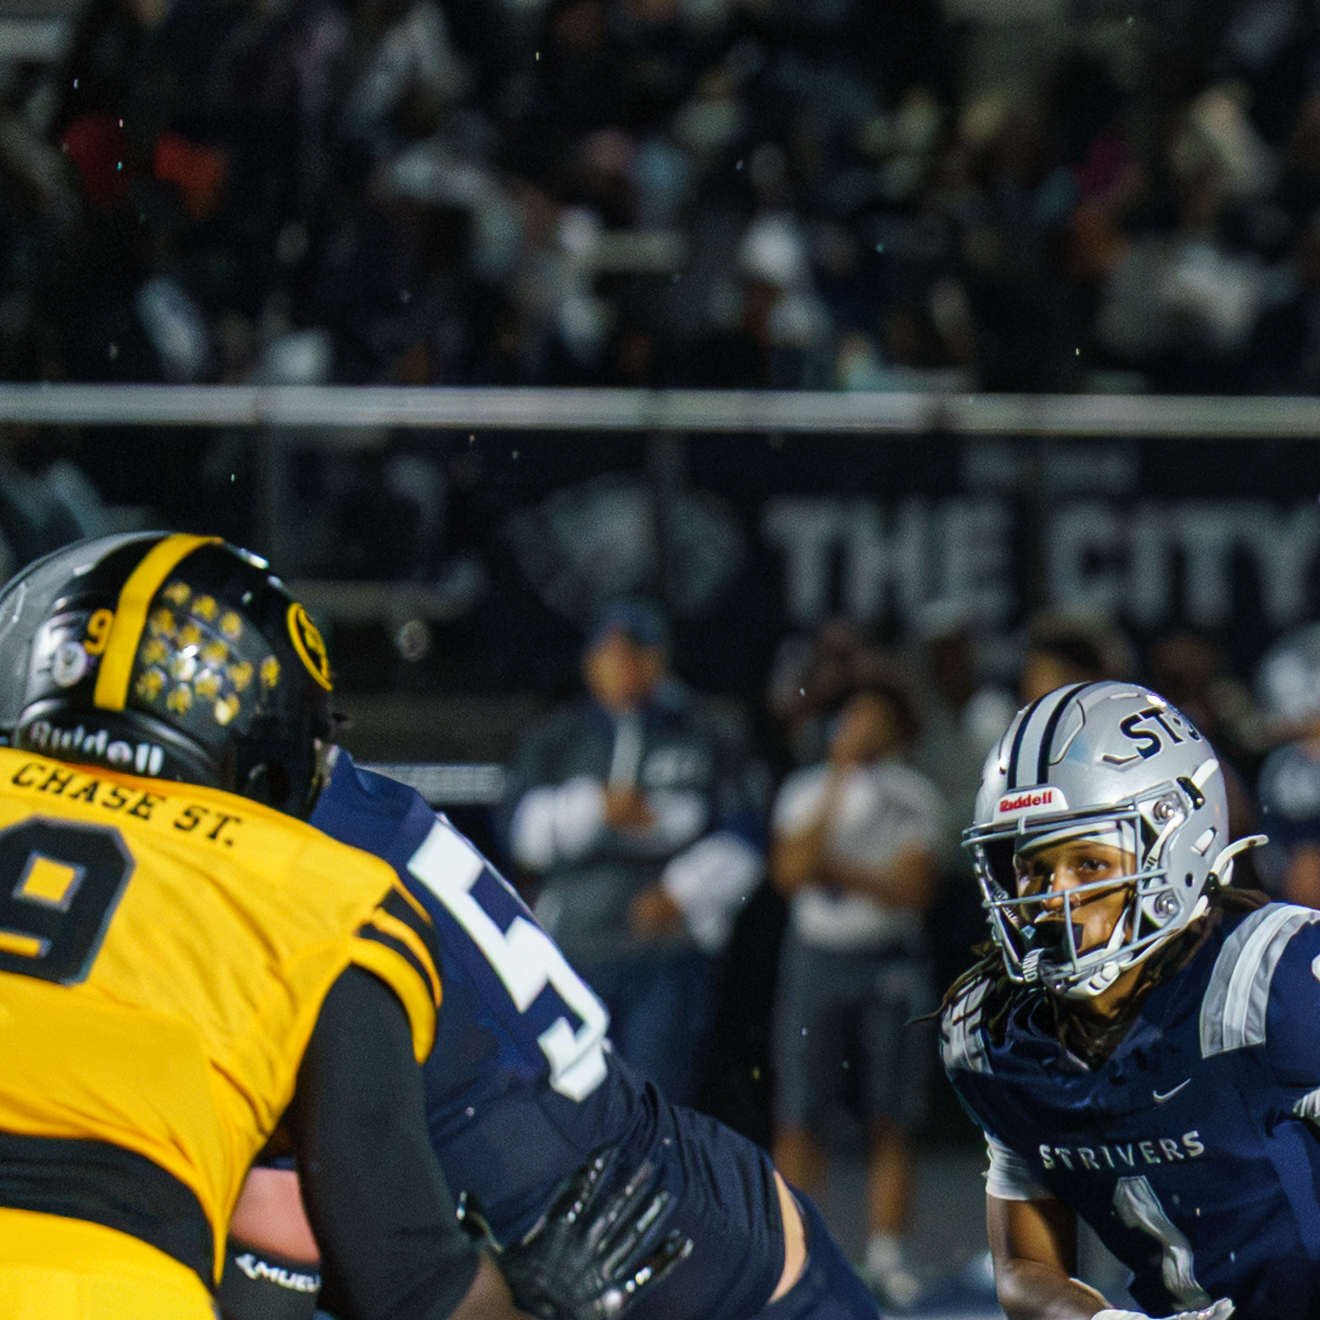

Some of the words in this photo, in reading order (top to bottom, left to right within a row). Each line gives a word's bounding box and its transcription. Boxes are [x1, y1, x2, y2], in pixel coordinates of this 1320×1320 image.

[762, 495, 1010, 618] THE
[11, 762, 166, 821] CHASE
[173, 805, 243, 847] ST.
[0, 814, 138, 990] 9
[1038, 1130, 1205, 1171] STRIVERS
